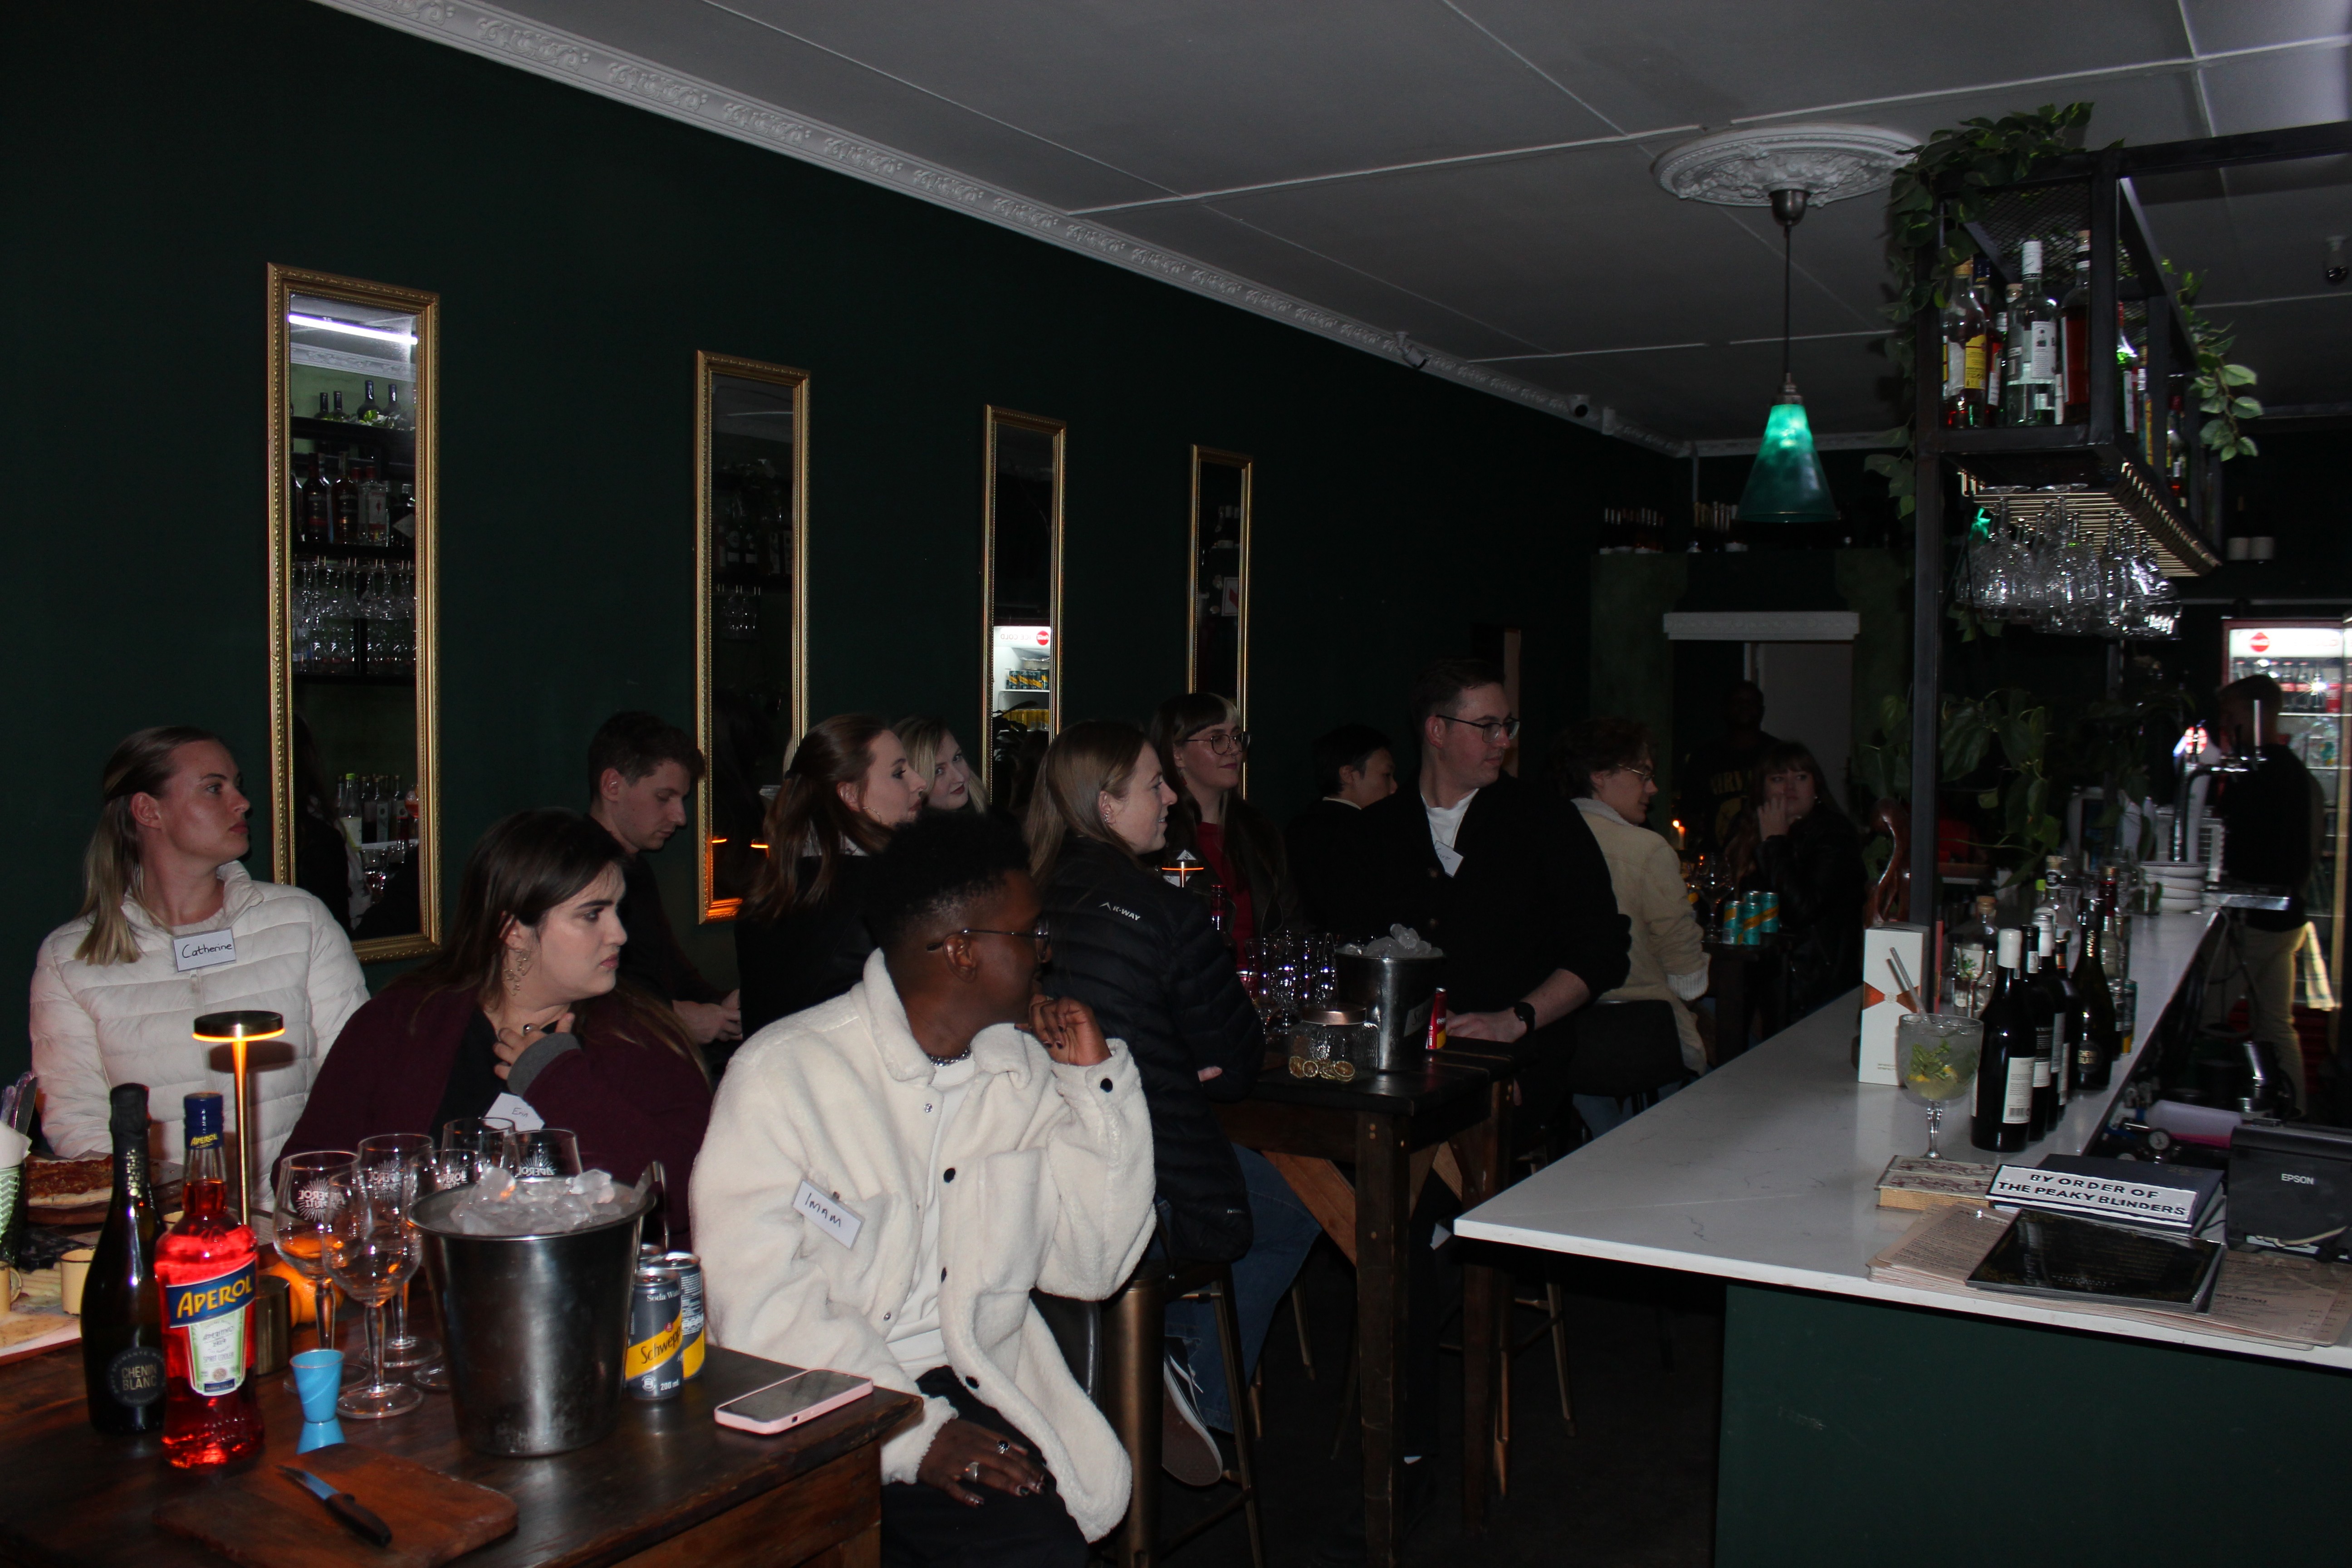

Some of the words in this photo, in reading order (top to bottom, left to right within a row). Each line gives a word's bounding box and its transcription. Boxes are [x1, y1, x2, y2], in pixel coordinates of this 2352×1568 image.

[1112, 906, 1141, 921] K-WAY
[182, 943, 233, 958] Catherine
[511, 1107, 528, 1117] Erin
[191, 1133, 219, 1146] APEROL
[2281, 1173, 2314, 1185] EPSON
[2030, 1174, 2054, 1182] BY
[2058, 1177, 2125, 1194] ORDER
[2131, 1189, 2160, 1200] OF
[1999, 1181, 2031, 1193] THE
[2034, 1187, 2097, 1201] PEAKY
[2098, 1196, 2186, 1216] BLINDERS
[176, 1275, 254, 1319] APEROL
[647, 1294, 666, 1302] Soda
[640, 1326, 681, 1364] Schwepp
[122, 1362, 158, 1379] CHENIN
[122, 1375, 157, 1391] BLANC
[660, 1381, 671, 1391] 200
